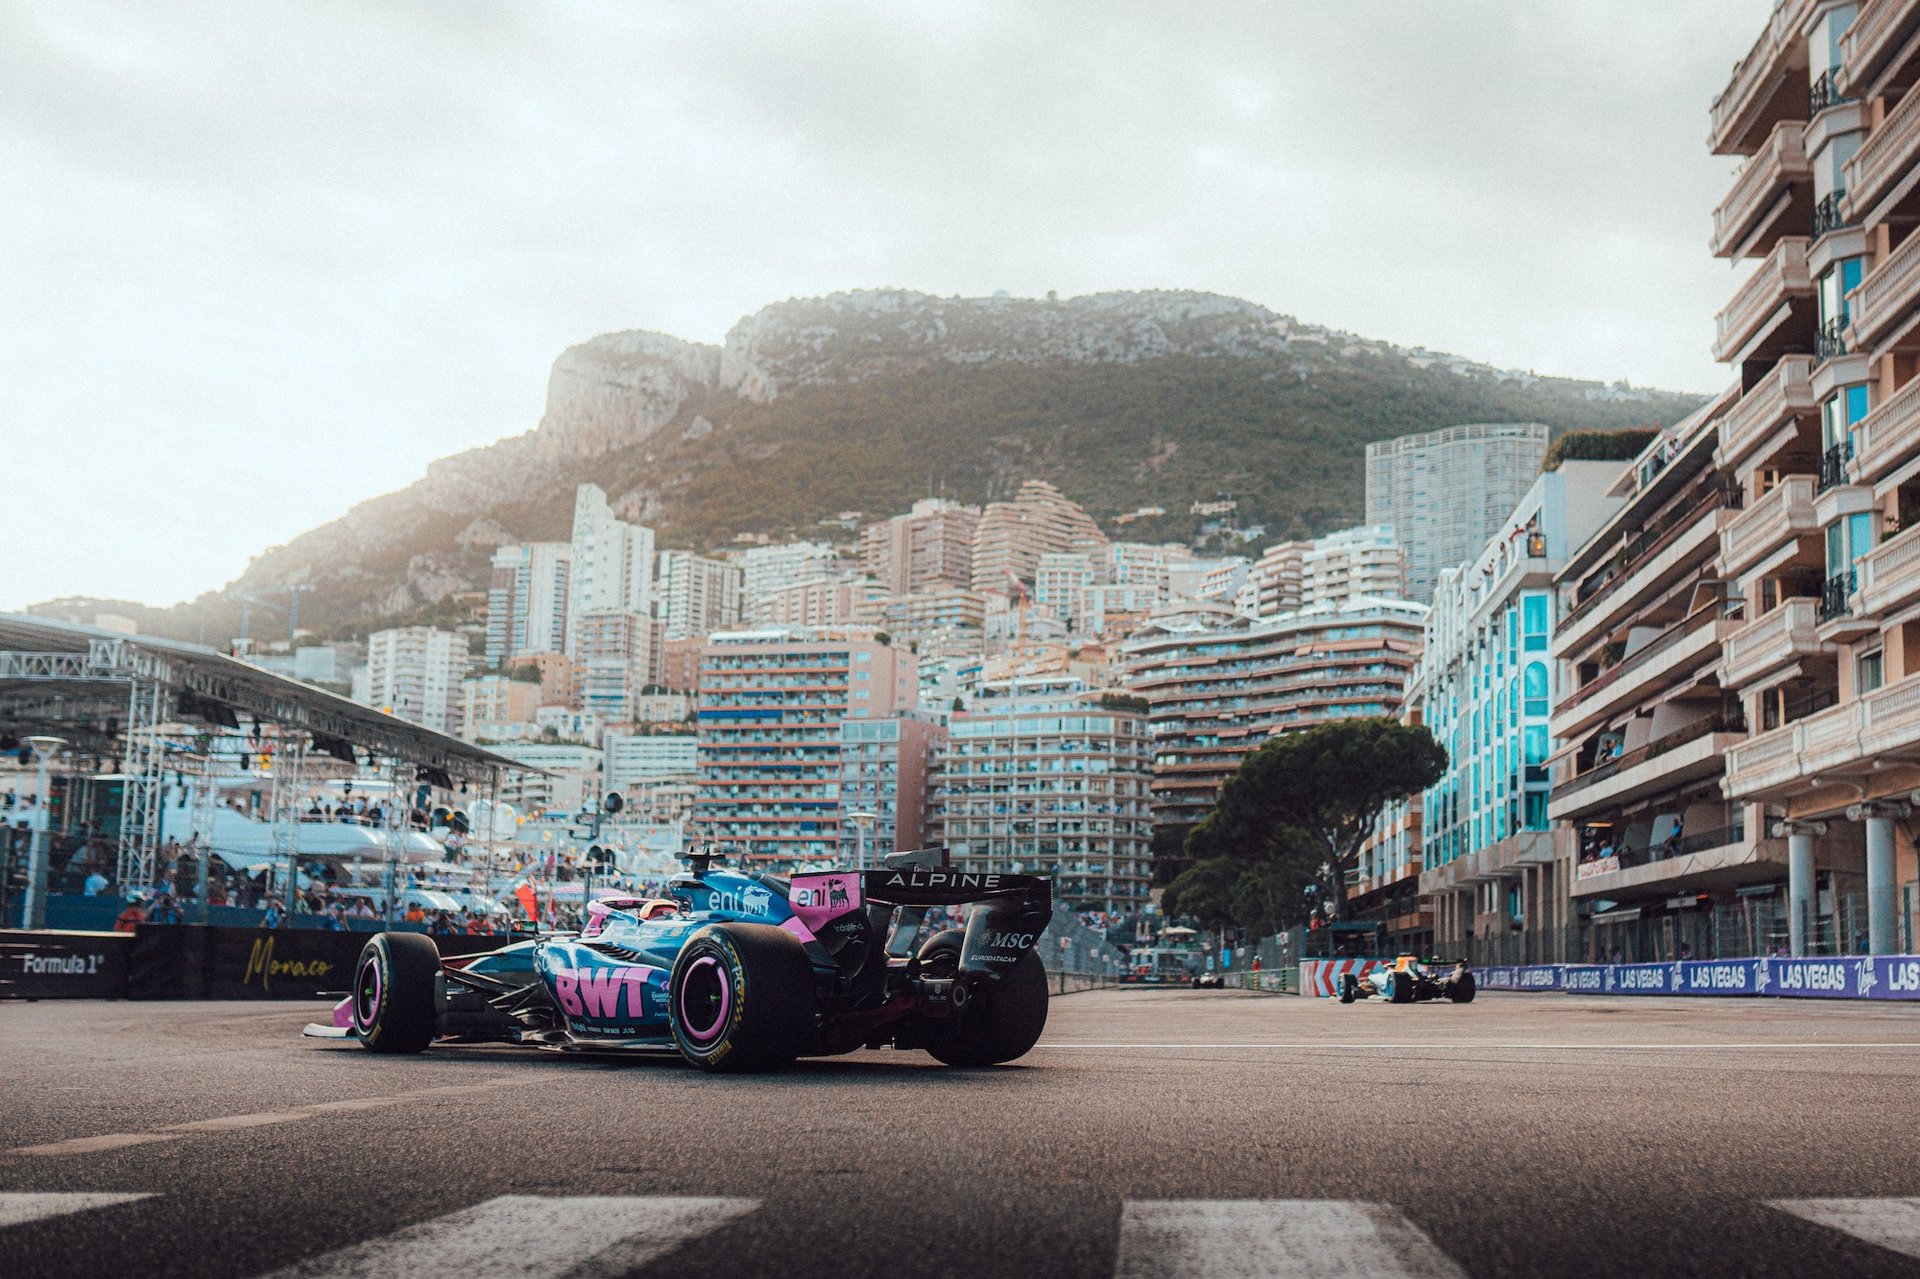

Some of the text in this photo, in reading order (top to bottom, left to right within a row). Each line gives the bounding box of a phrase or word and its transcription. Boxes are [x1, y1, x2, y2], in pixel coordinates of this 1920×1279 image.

[886, 872, 1001, 888] ALPINE
[708, 886, 742, 911] eni
[797, 881, 826, 907] eni
[990, 932, 1033, 949] MSC
[24, 953, 85, 973] Formula
[244, 936, 333, 991] Monaco
[1620, 969, 1635, 988] LAS
[1636, 969, 1663, 988] VEGAS
[1690, 967, 1709, 988] LAS
[1710, 966, 1745, 988] VEGAS
[1779, 965, 1801, 989] LAS
[1803, 965, 1845, 990] VEGAS
[1888, 962, 1919, 991] LAS
[556, 967, 652, 1018] BWT
